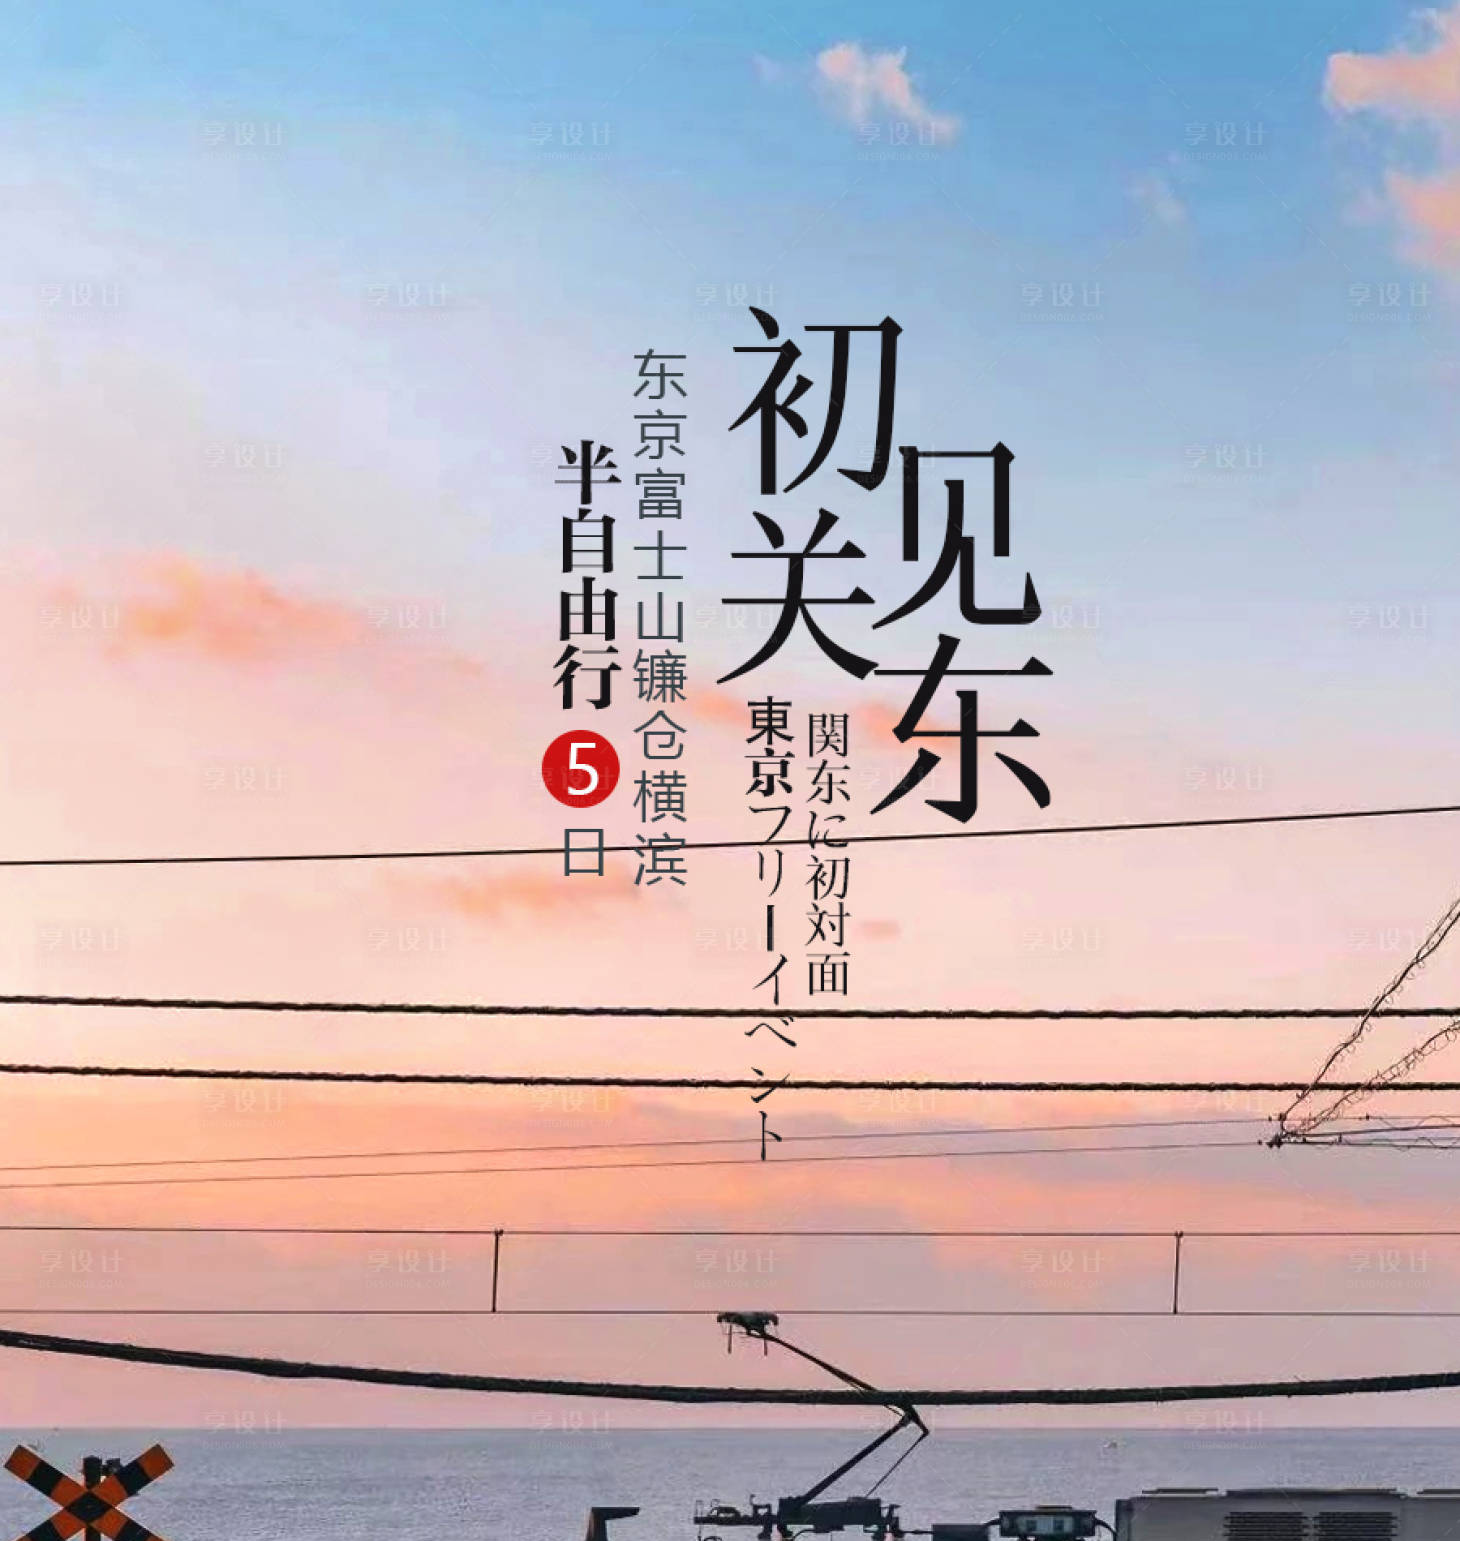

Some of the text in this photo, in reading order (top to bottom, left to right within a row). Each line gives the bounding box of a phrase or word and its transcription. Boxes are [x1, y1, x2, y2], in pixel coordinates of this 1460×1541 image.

[633, 348, 688, 887] 东京富士山镰仓横滨
[745, 695, 797, 1161] 東京フリーイベント
